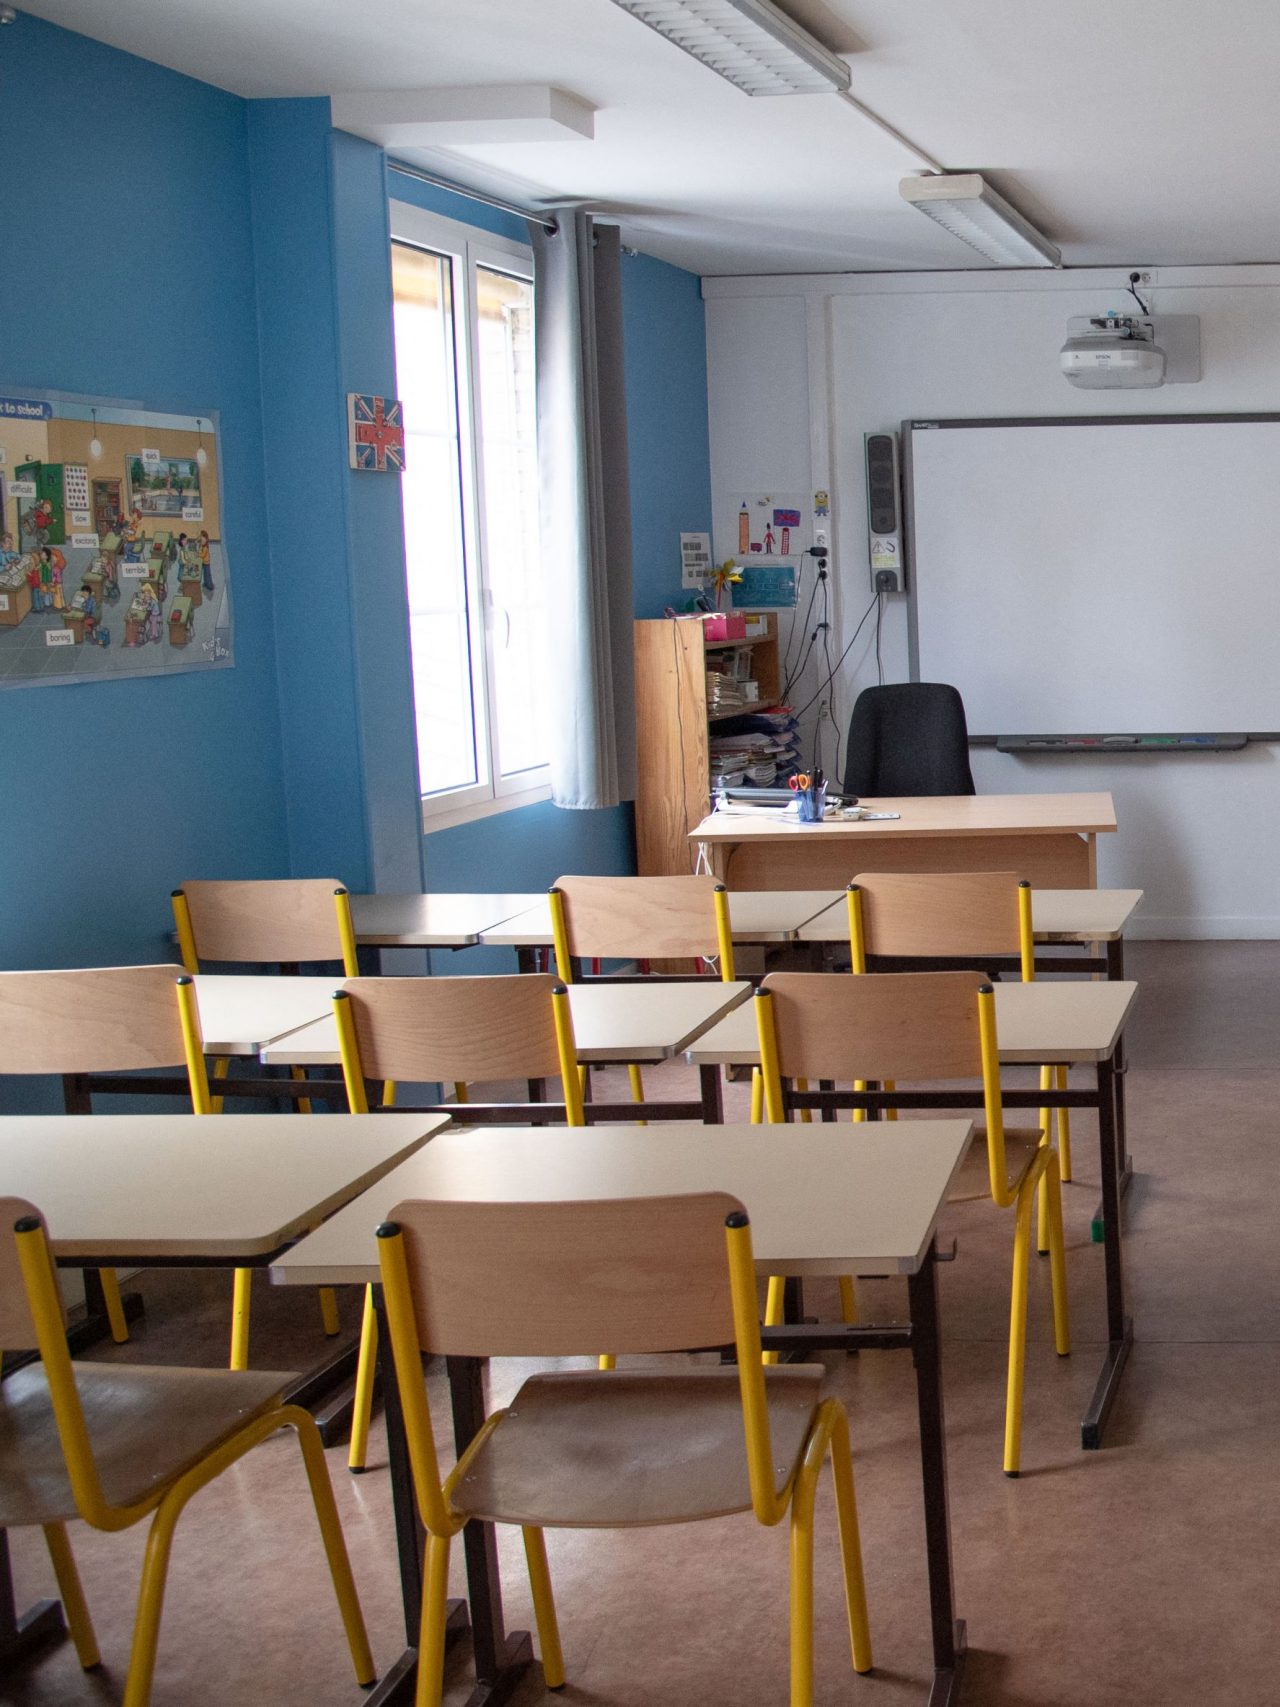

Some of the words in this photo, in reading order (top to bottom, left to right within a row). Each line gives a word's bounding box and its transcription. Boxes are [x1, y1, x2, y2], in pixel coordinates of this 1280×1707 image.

[5, 402, 16, 413] to
[17, 403, 43, 416] school
[125, 566, 147, 574] terrible
[49, 634, 71, 643] boring
